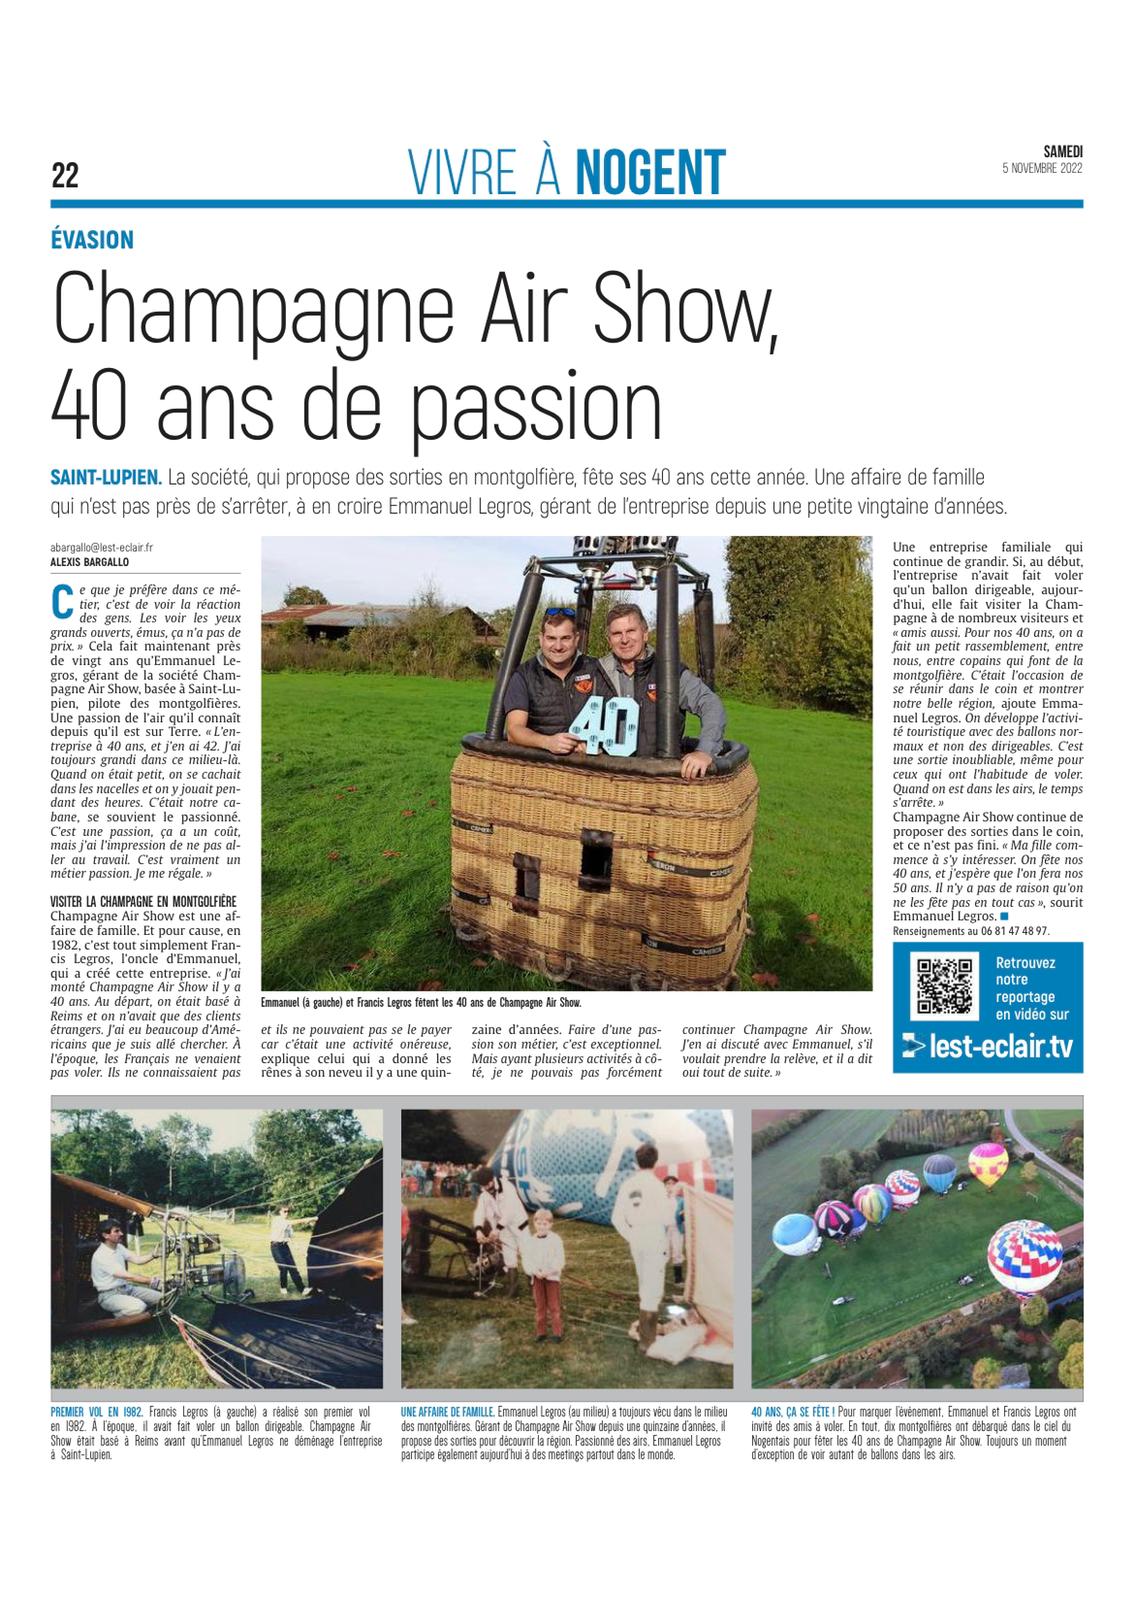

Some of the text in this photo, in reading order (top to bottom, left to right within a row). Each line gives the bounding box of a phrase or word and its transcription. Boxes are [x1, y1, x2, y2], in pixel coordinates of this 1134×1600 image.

[1043, 144, 1084, 159] SAMEDI
[52, 162, 78, 188] 22
[408, 140, 726, 195] VIVRE À NOGENT
[1002, 161, 1083, 174] 5 NOVEMBRE 2022
[52, 226, 133, 249] ÉVASION
[56, 269, 777, 361] Champagne Air Show,
[51, 366, 660, 457] 40 ans de passion
[51, 468, 984, 489] SAINT-LUPIEN. La société, qui propose des sorties en montgolfière, fête ses 40 ans cette année. Une affaire de famille
[51, 497, 1006, 518] qui n'est pas près de s'arrêter, à en croire Emmanuel Legros, gérant de l'entreprise depuis une petite vingtaine d'années.
[50, 542, 153, 555] abargallo@lest-eclair.fr
[49, 556, 130, 567] ALEXIS BARGALLO
[892, 553, 1084, 569] continue de grandir. Si, au début,
[50, 711, 241, 726] Une passion de l'air qu'il connaît
[569, 695, 640, 757] 40
[50, 753, 241, 768] toujours grandi dans ce milieu-là.
[893, 752, 1085, 768] une sortie inoubliable, même pour
[892, 810, 1084, 825] Champagne Air Show continue de
[49, 893, 237, 908] VISITER LA CHAMPAGNE EN MONTGOLFIÈRE
[893, 925, 1051, 939] Renseignements au 06 81 47 48 97.
[996, 956, 1056, 969] Retrouvez
[996, 973, 1029, 986] notre
[260, 996, 582, 1010] Emmanuel (à gauche) et Francis Legros fêtent les 40 ans de Champagne Air Show.
[996, 991, 1056, 1006] reportage
[995, 1007, 1070, 1021] en vidéo sur
[682, 1023, 873, 1038] continuer Champagne Air Show.
[931, 1033, 1073, 1058] lest-eclair.tv
[261, 1052, 452, 1067] explique celui qui a donné les
[400, 1405, 728, 1420] UNE AFFAIRE DE FAMILLE. Emmanuel Legros (au milieu) a toujours vécu dans le milieu
[50, 1447, 113, 1462] à Saint-Lupien.
[751, 1449, 956, 1462] d'exception de voir autant de ballons dans les airs.
